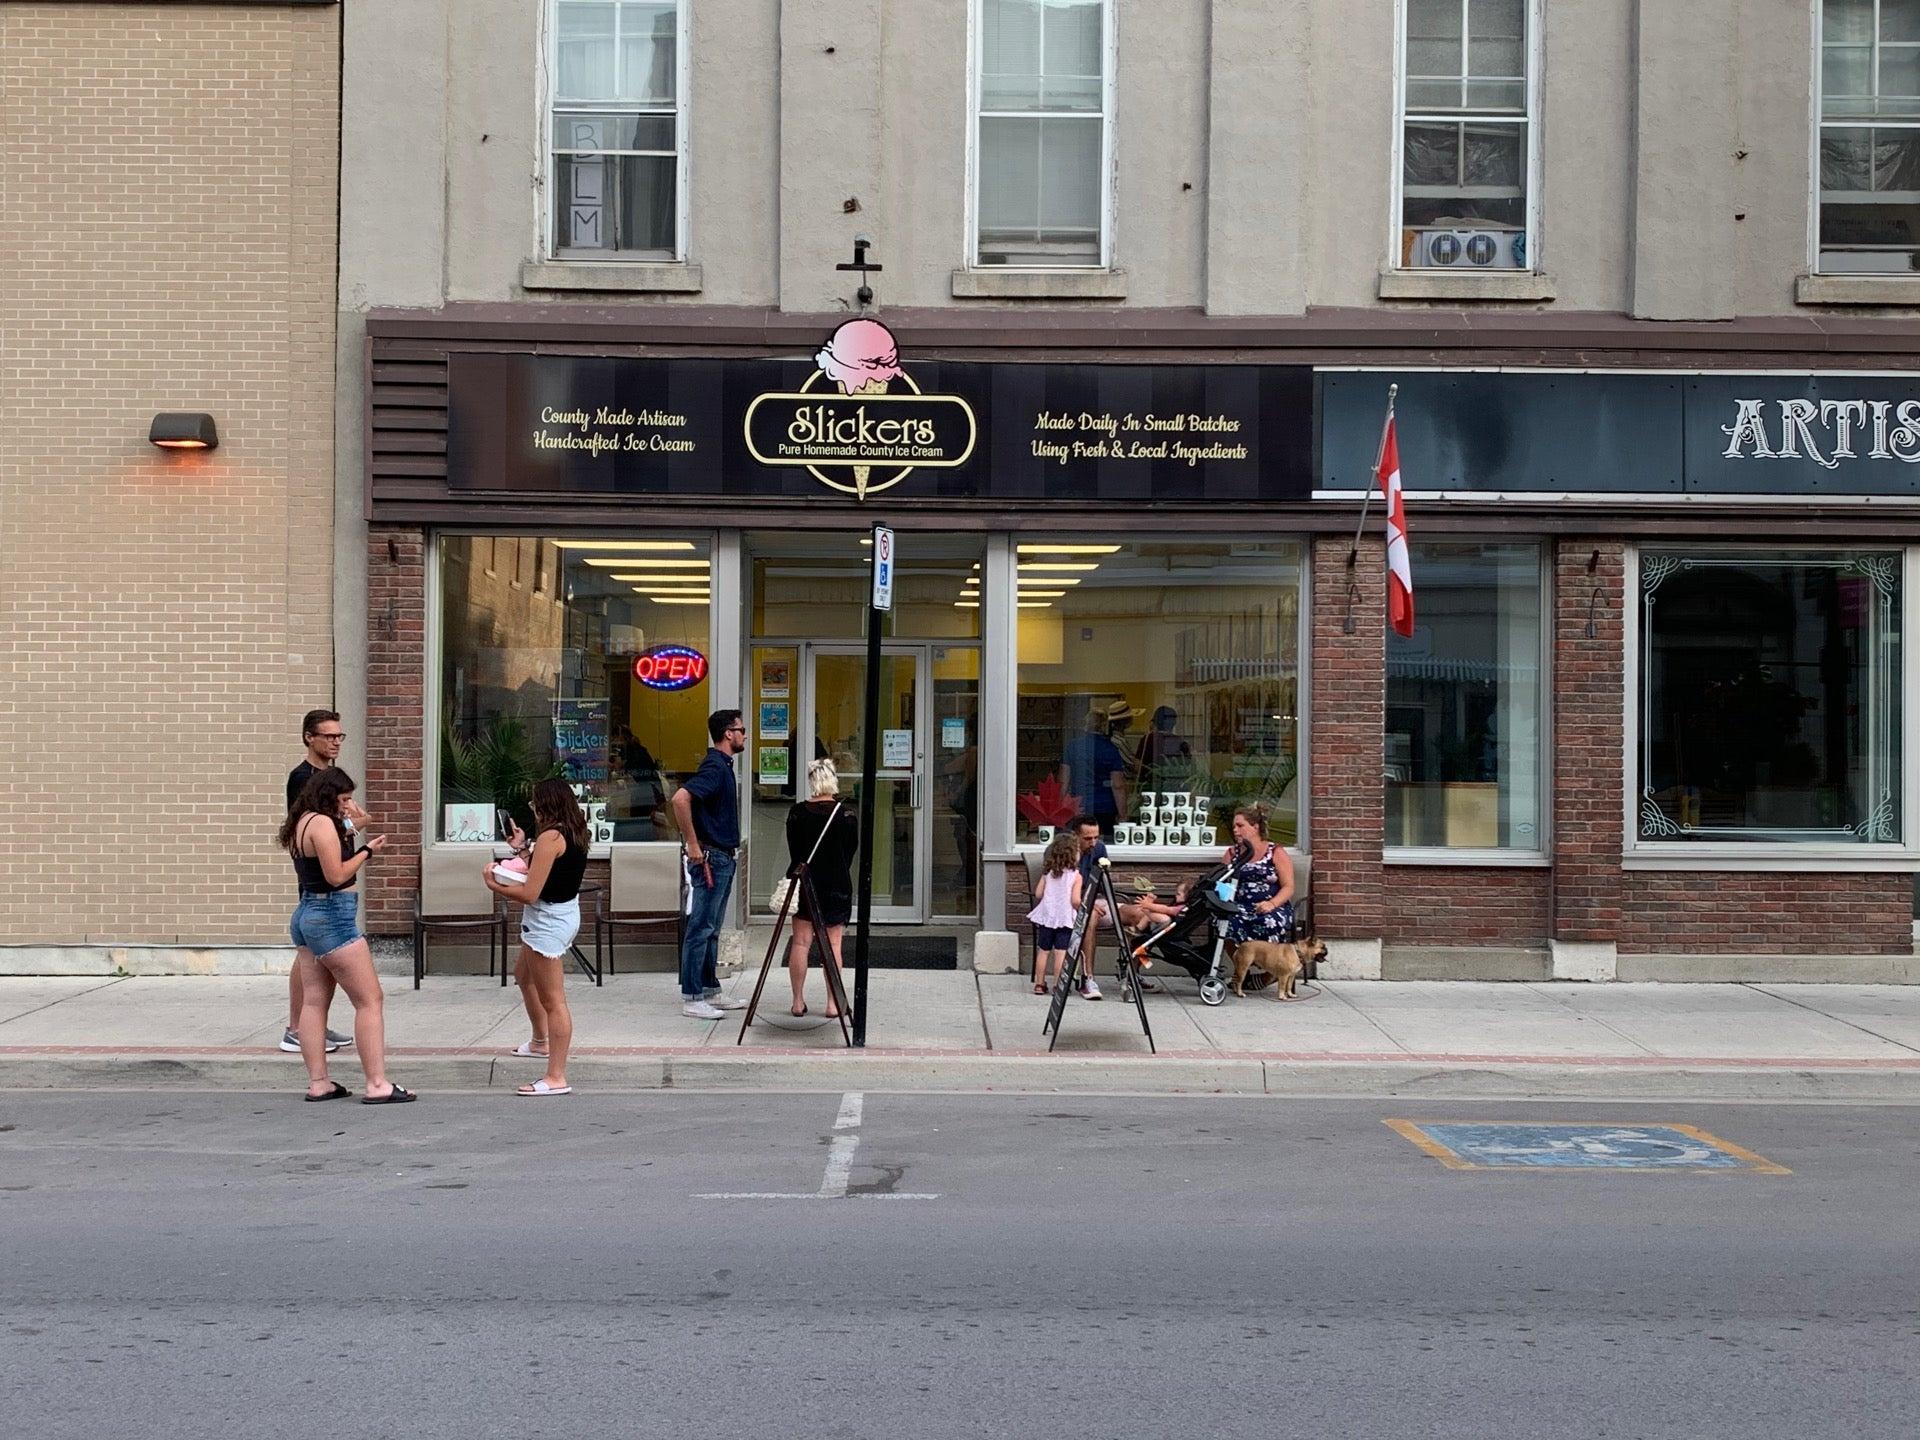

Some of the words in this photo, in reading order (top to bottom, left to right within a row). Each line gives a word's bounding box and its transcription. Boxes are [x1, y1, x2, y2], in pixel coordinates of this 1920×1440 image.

[541, 406, 590, 432] County
[593, 406, 634, 426] Made
[637, 409, 687, 427] Artisan
[787, 405, 936, 445] Slickers
[1034, 411, 1075, 430] Made
[1077, 412, 1118, 438] Daily
[1121, 413, 1142, 431] In
[1144, 413, 1185, 432] Small
[1187, 413, 1240, 432] Batches
[533, 430, 620, 458] Handcrafted
[623, 432, 647, 450] Ice
[650, 434, 696, 452] Cream
[778, 443, 801, 455] Pure
[803, 444, 857, 456] Homemade
[859, 444, 895, 457] County
[895, 446, 909, 457] Ice
[911, 446, 943, 457] Cream
[1030, 440, 1069, 464] Using
[1072, 440, 1109, 458] Fresh
[1111, 440, 1126, 459] &
[1128, 441, 1168, 459] Local
[1170, 441, 1248, 466] Ingredients
[636, 657, 704, 679] OPEN
